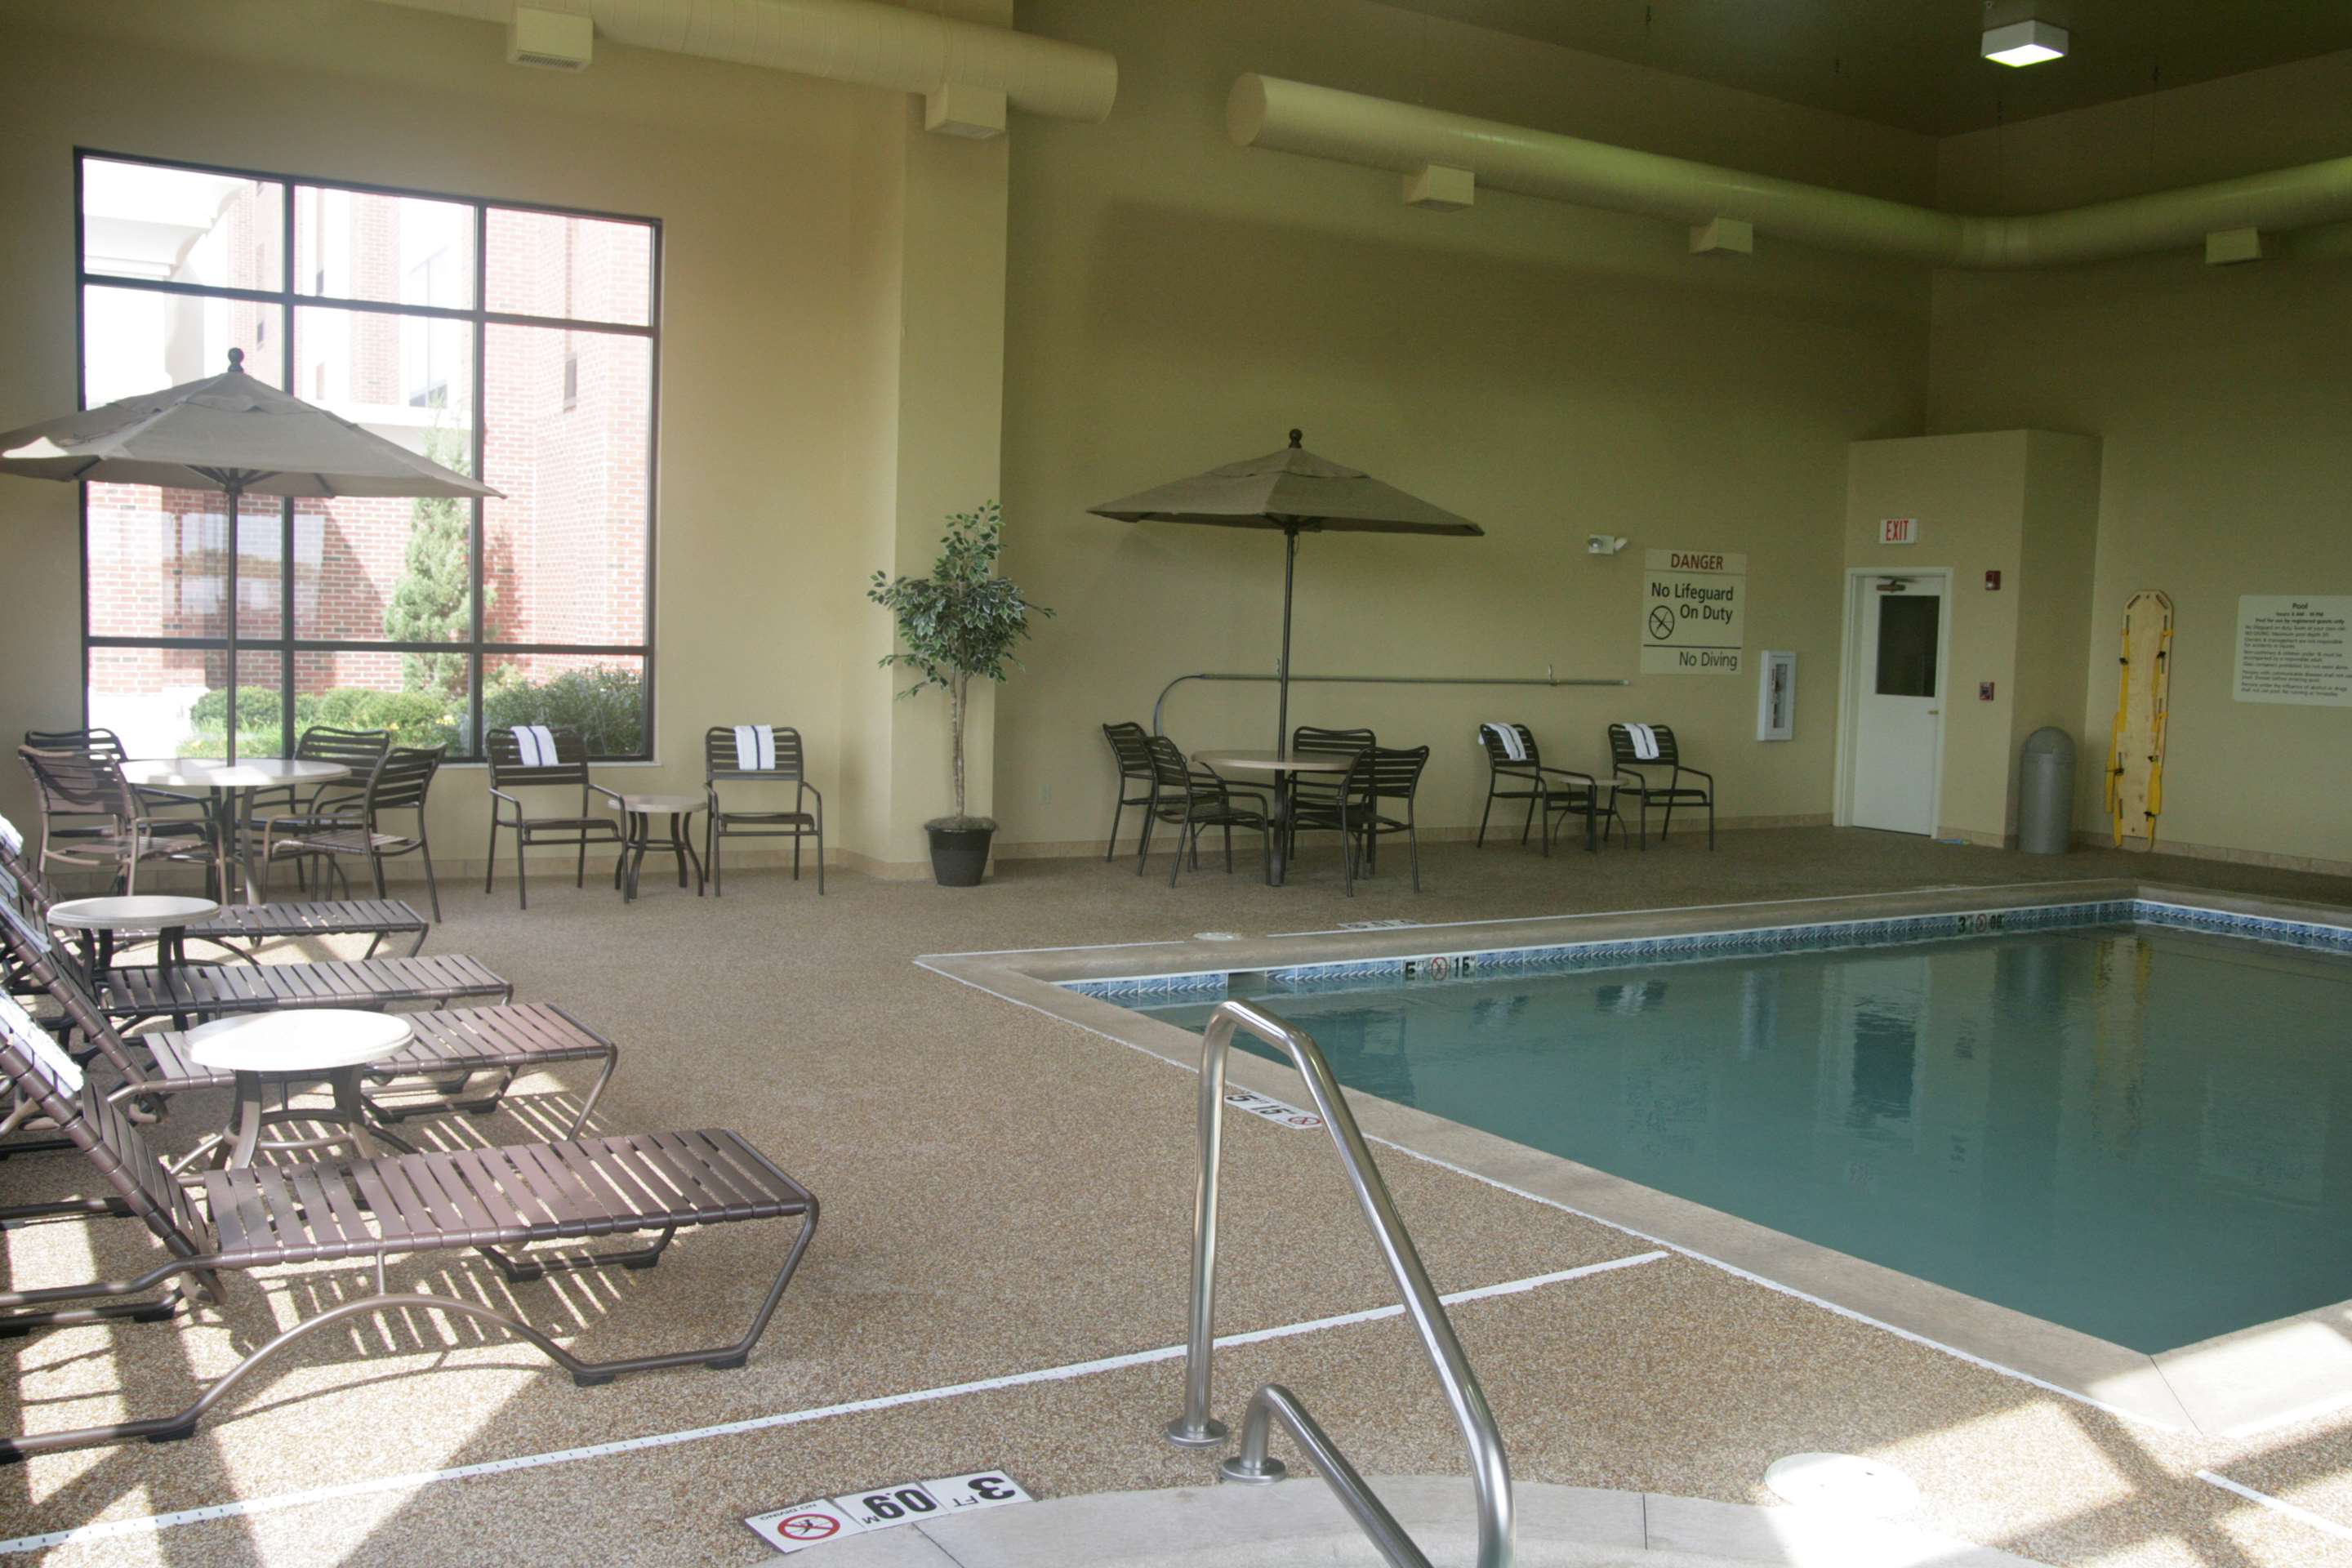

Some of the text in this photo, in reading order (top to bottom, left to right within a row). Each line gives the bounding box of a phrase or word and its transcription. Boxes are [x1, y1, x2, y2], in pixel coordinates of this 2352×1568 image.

[1886, 520, 1909, 541] EXIT
[1671, 554, 1723, 570] DANGER
[1651, 582, 1734, 604] No Lifeguard
[1680, 604, 1733, 625] On Duty
[1679, 652, 1737, 671] No Diving
[952, 1477, 1016, 1508] 3 FT
[760, 1503, 817, 1521] NO DIVING
[862, 1515, 881, 1525] M
